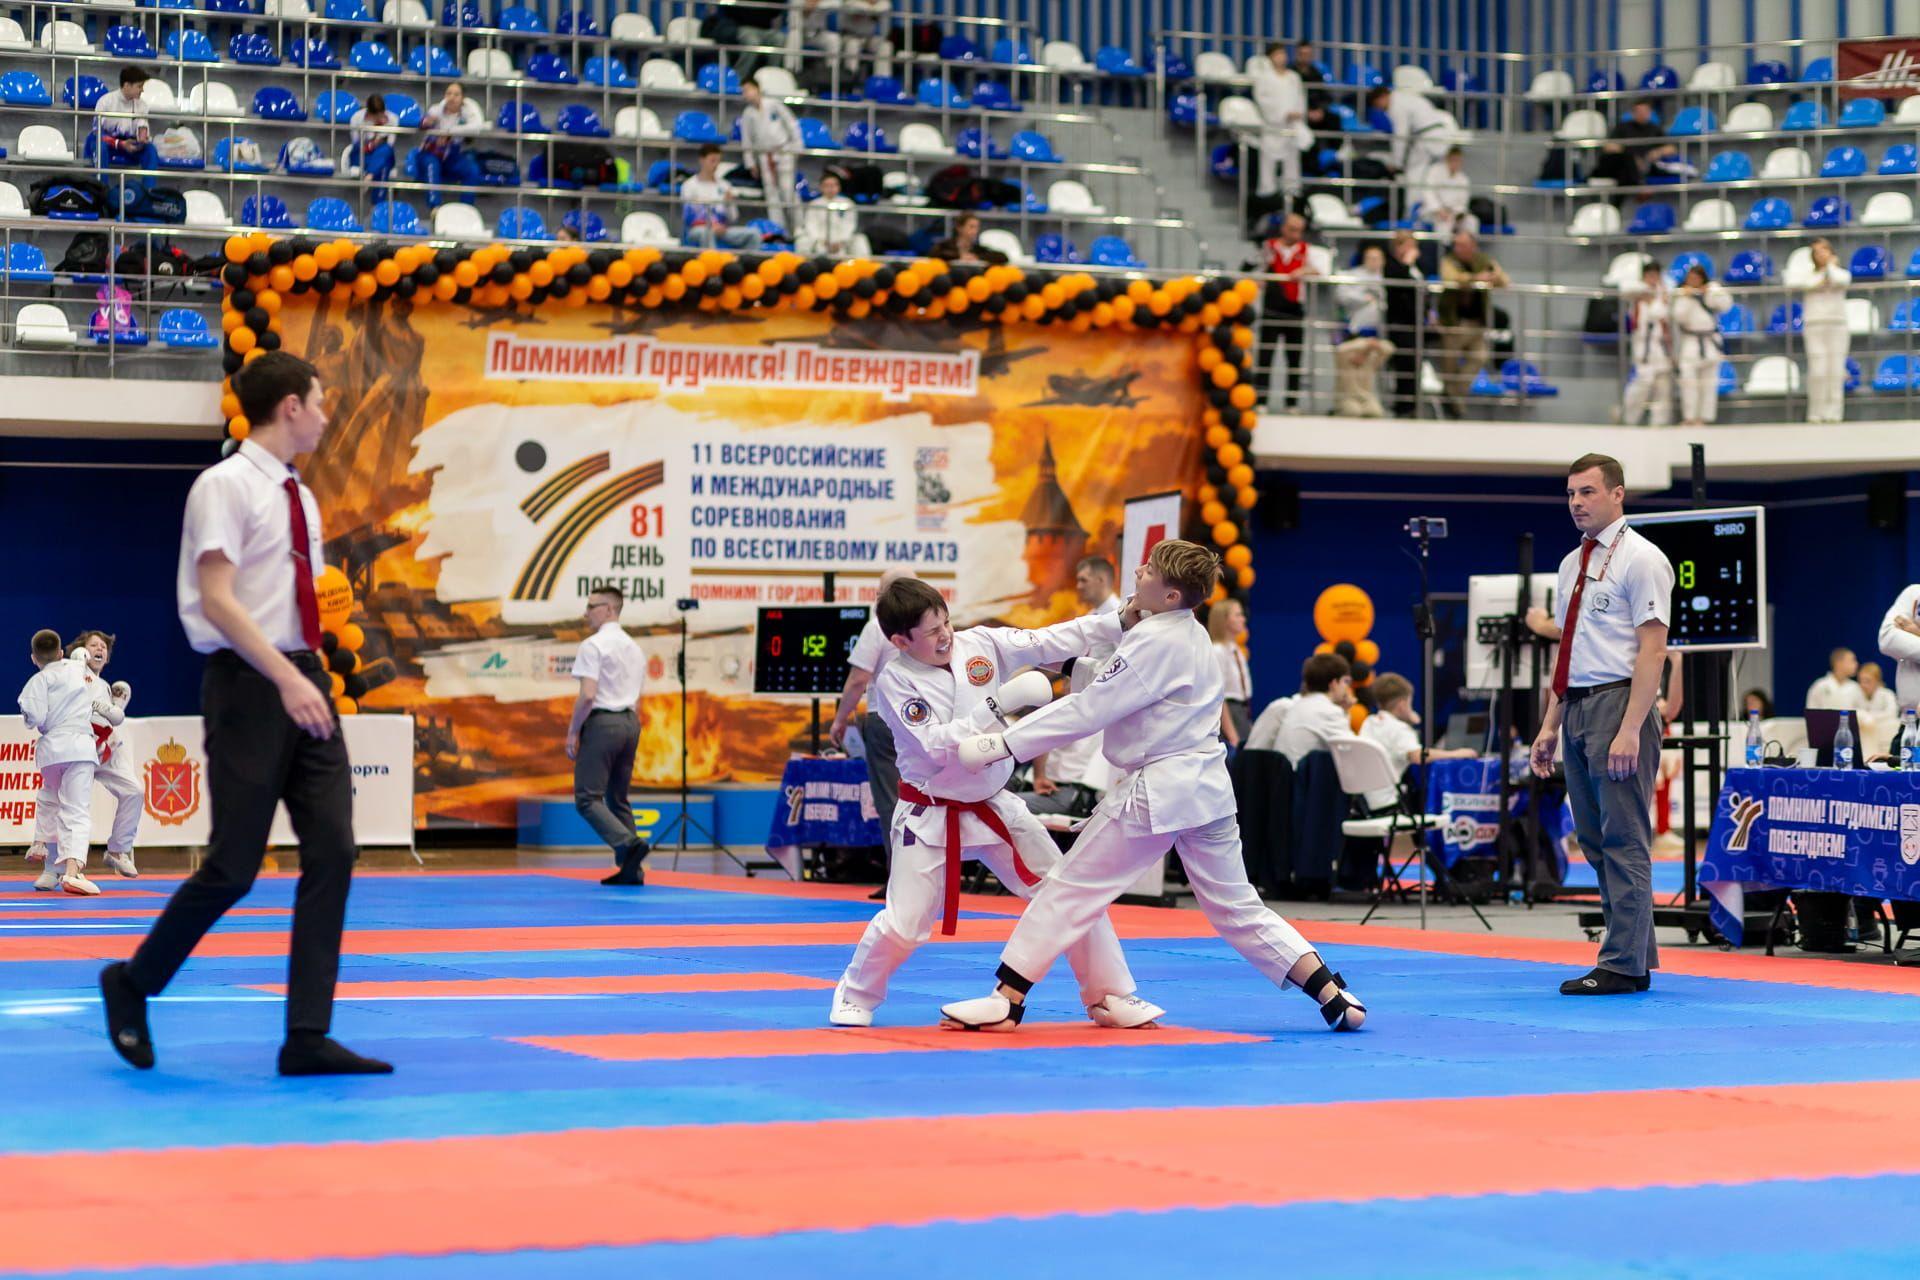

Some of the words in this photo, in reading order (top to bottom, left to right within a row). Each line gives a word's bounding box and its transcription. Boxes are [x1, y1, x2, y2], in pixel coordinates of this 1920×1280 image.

[492, 339, 625, 375] Помним!
[635, 343, 786, 387] Гордимся!
[795, 349, 973, 393] Побеждаем!
[691, 443, 712, 464] 11
[721, 443, 886, 469] ВСЕРОССИЙСКИЕ
[691, 475, 704, 495] И
[710, 475, 895, 500] МЕЖДУНАРОДНЫЕ
[630, 504, 664, 538] 81
[691, 506, 846, 529] СОРЕВНОВАНИЯ
[1714, 523, 1746, 536] SHIRO
[611, 544, 665, 570] ДЕНЬ
[690, 538, 717, 559] ПО
[723, 538, 879, 561] ВСЕСТИЛЕВОМУ
[885, 541, 959, 562] КАРАТЭ
[771, 635, 782, 657] 0
[349, 765, 389, 778] орта
[1768, 796, 1826, 824] ПОМНИМ!
[1829, 800, 1899, 831] ГОРДИМСЯ!
[1768, 829, 1846, 859] ПОБЕЖДАЕМ!
